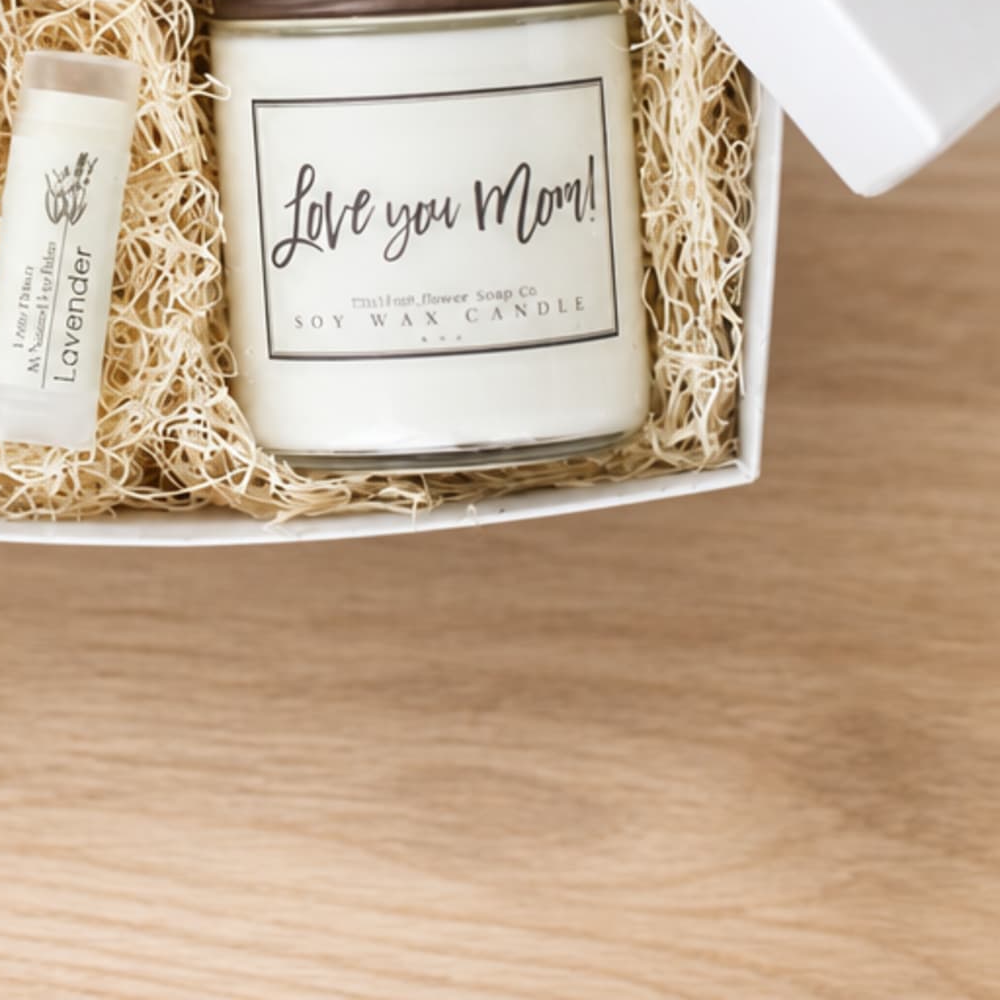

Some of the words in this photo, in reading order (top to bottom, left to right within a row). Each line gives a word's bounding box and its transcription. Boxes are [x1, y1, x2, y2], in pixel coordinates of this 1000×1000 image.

[271, 163, 376, 269] Love
[383, 196, 462, 262] you
[474, 154, 597, 245] Mom!
[53, 246, 92, 384] Lavender
[294, 314, 344, 330] SOY
[369, 311, 440, 328] WAX
[464, 296, 586, 325] CANDLE
[476, 287, 513, 303] Soap
